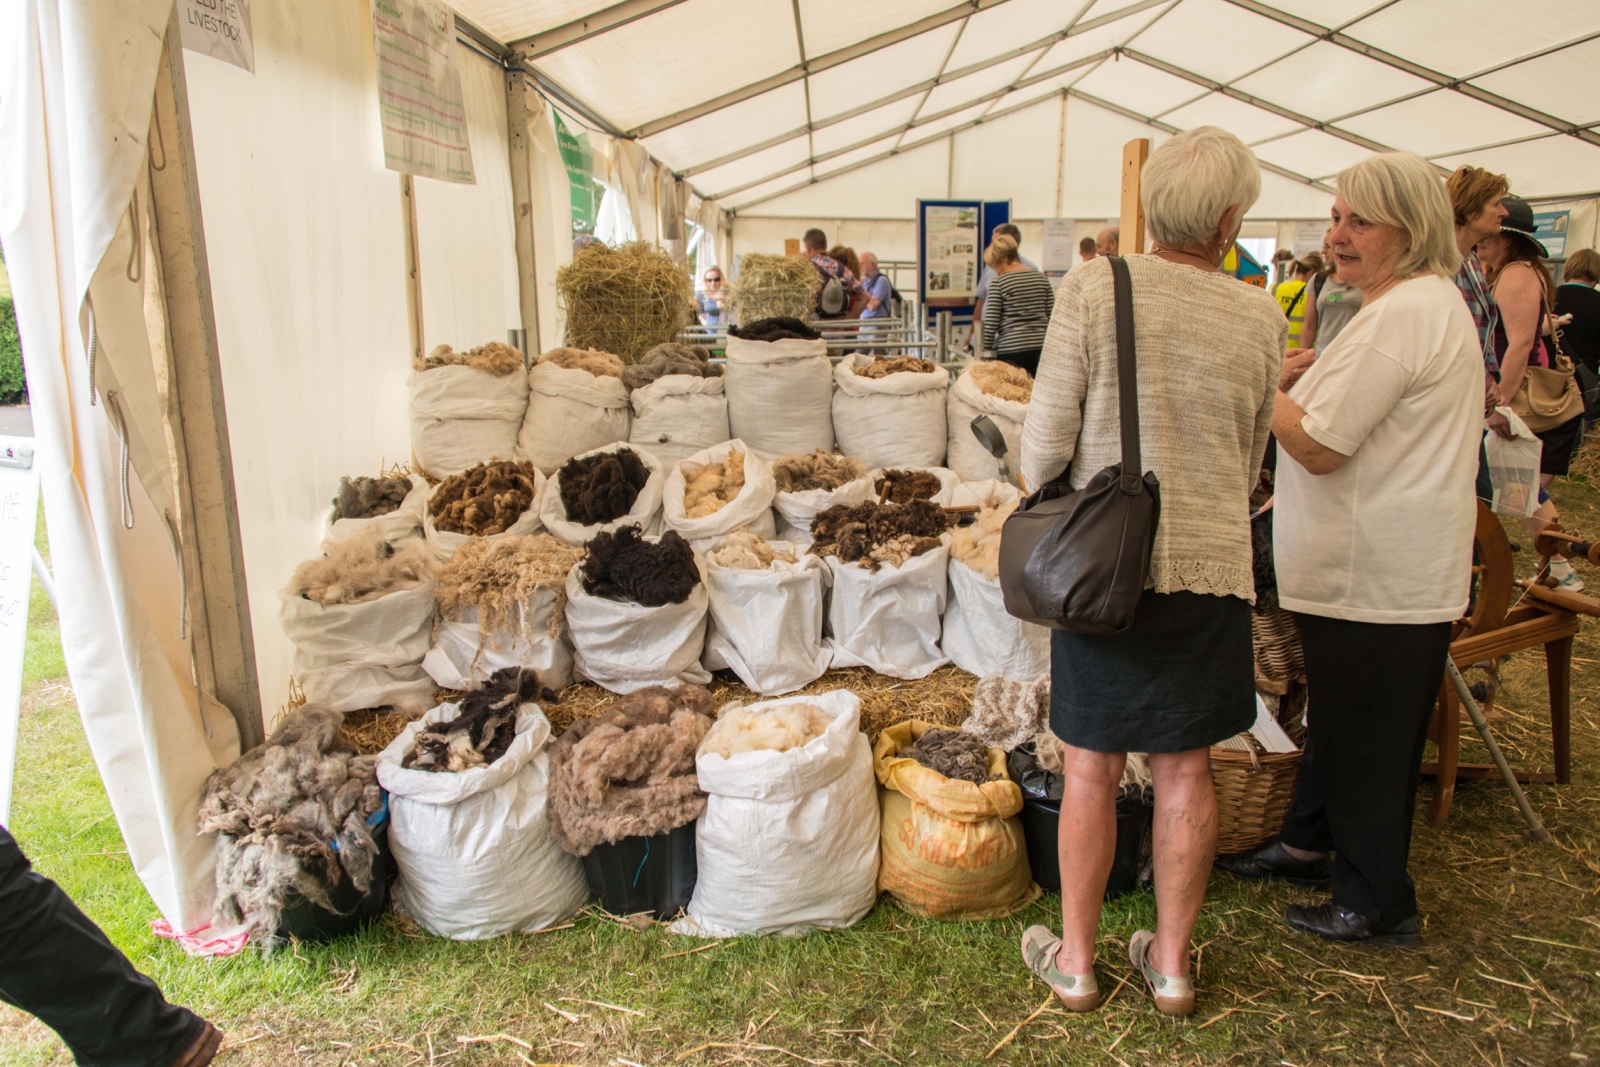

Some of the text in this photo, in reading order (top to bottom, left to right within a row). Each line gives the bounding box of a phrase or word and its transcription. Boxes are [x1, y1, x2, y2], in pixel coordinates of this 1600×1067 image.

[187, 7, 242, 43] LIVESTOCK
[918, 832, 969, 870] KILOS
[972, 832, 1012, 870] NETT
